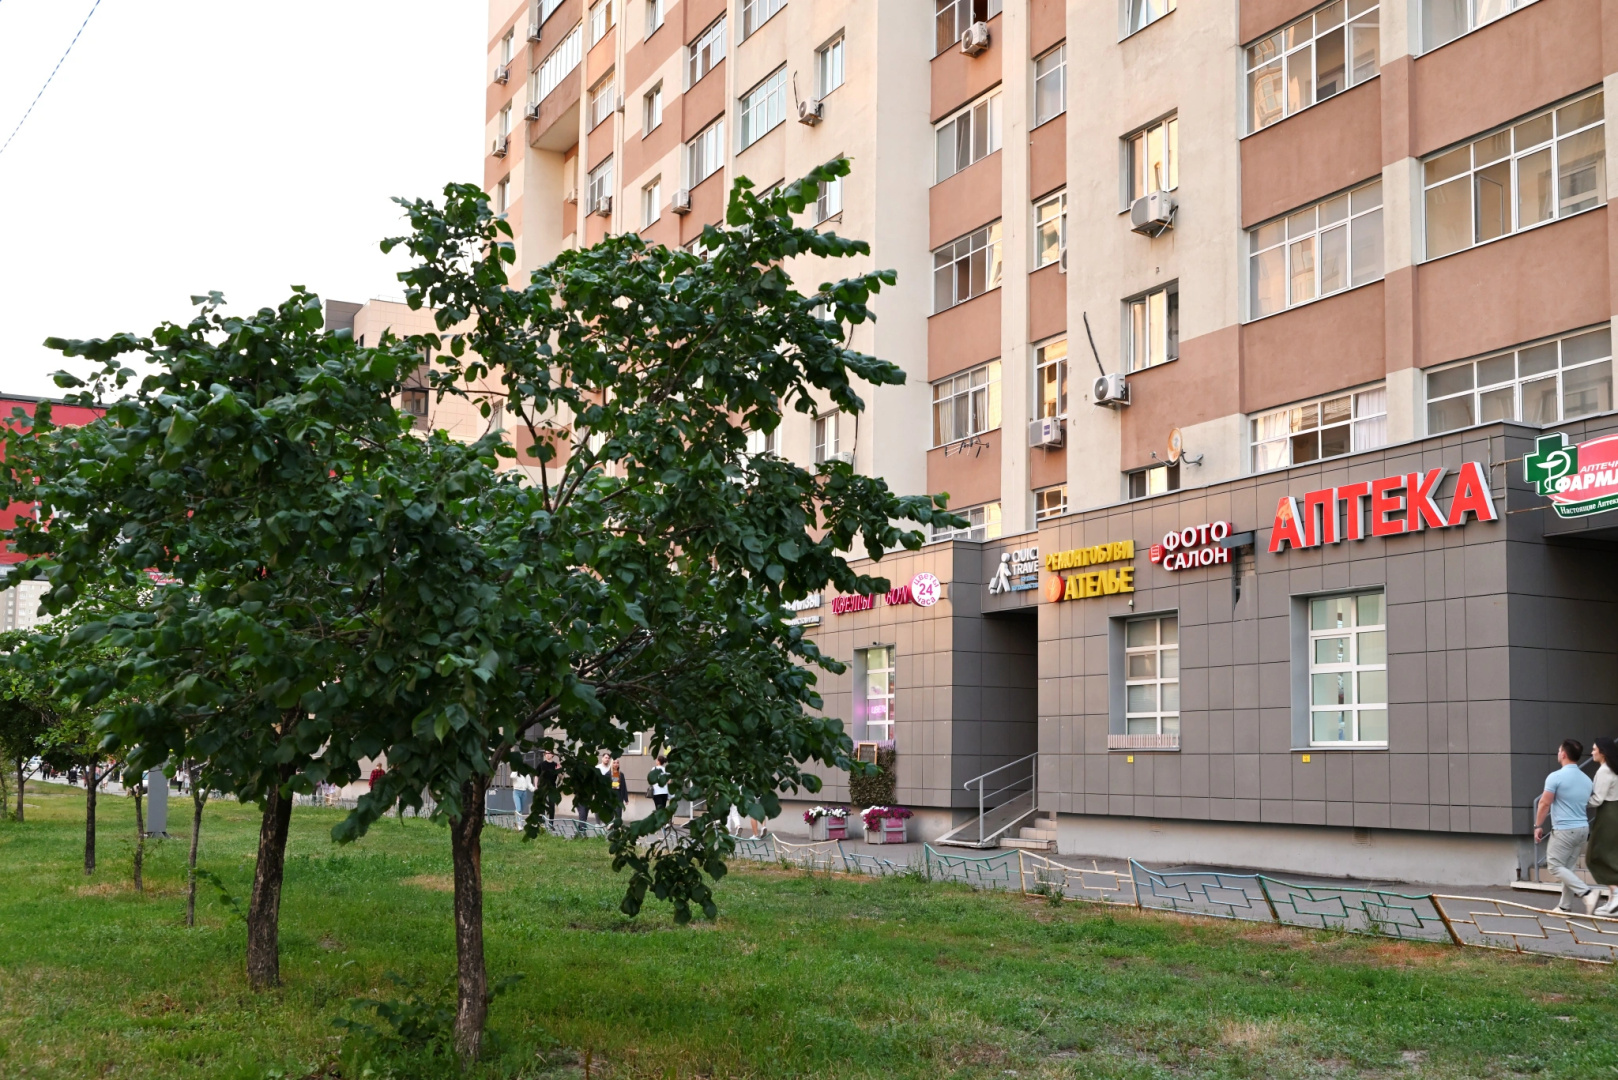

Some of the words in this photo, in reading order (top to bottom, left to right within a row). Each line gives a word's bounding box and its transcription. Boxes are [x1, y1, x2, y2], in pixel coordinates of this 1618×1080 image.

[1267, 461, 1497, 552] АПТЕКА
[1560, 504, 1596, 515] Настоящие
[1162, 521, 1231, 551] ФОТО
[1012, 547, 1038, 563] QUIC
[1162, 547, 1230, 571] САЛОН
[918, 582, 934, 596] 24
[1064, 566, 1134, 600] АТЕЛЬЕ
